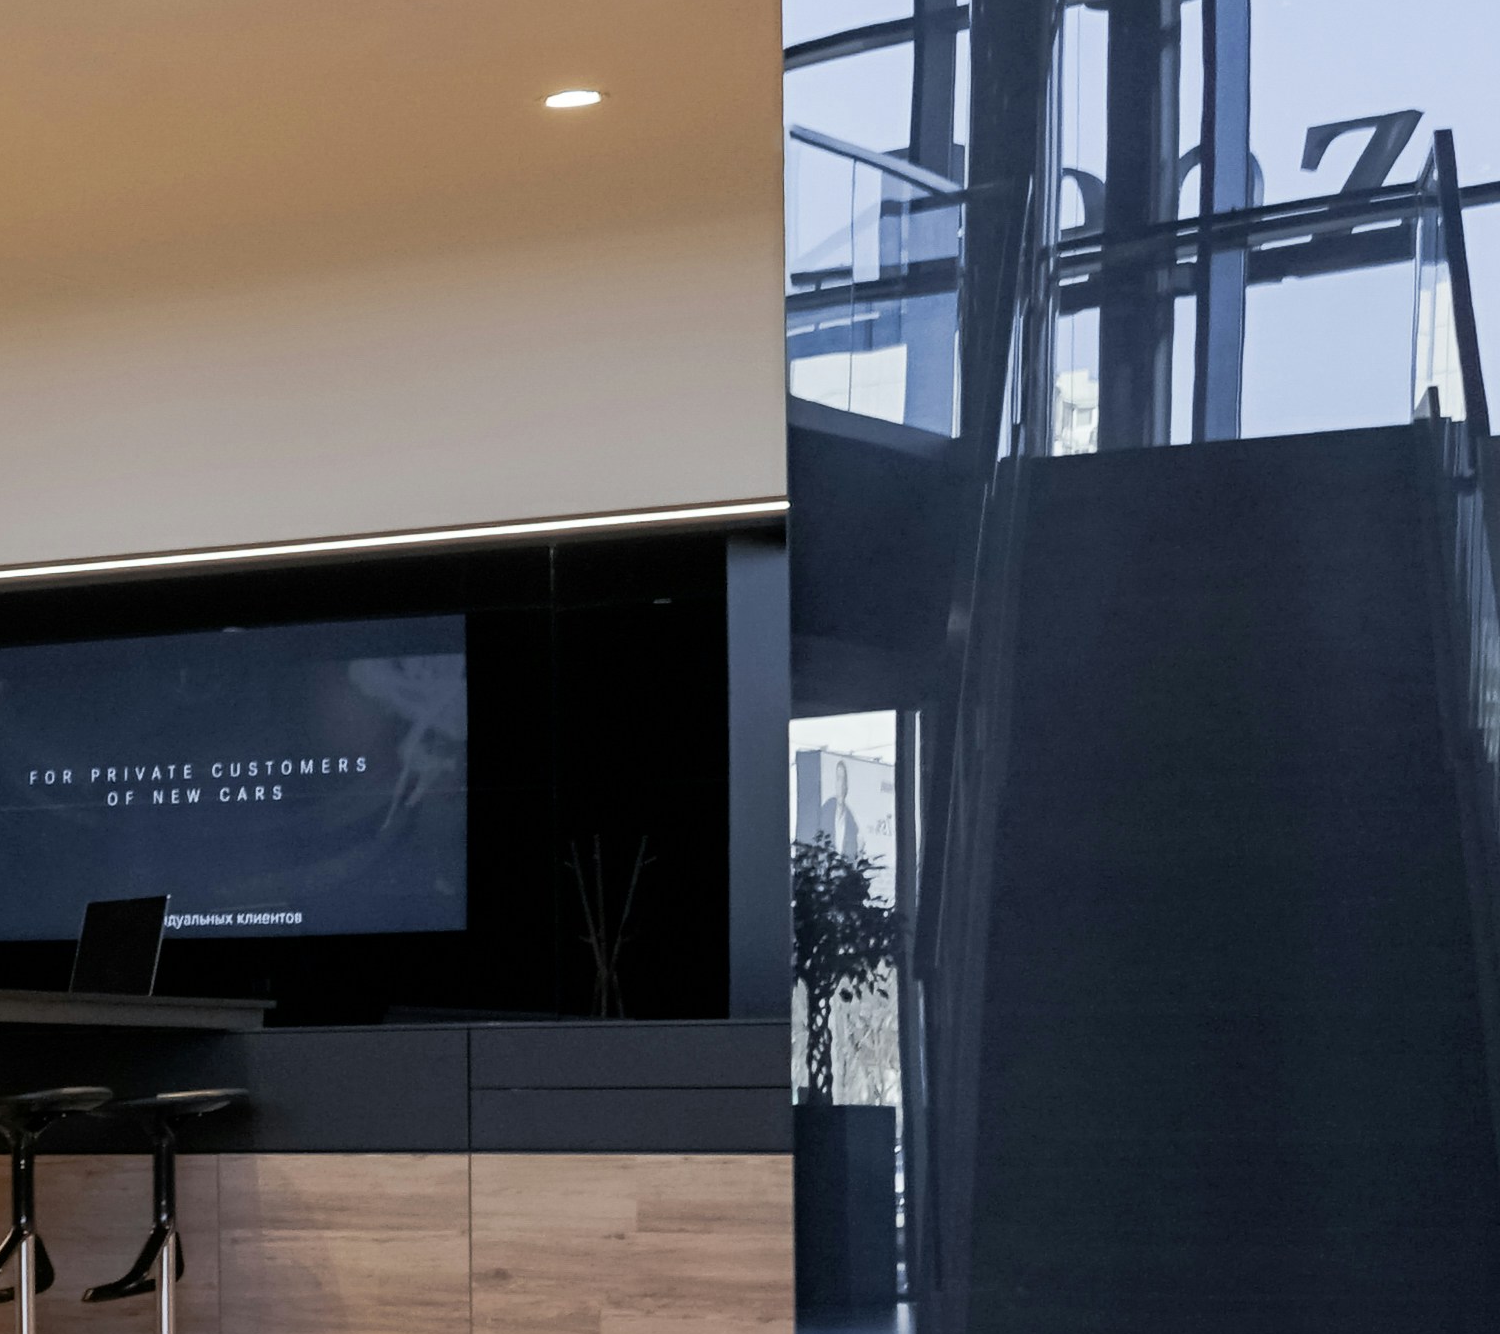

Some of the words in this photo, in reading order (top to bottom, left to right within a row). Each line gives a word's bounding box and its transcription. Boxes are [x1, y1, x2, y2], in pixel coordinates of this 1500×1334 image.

[29, 769, 73, 785] FOR
[91, 764, 193, 783] PRIVATE
[211, 757, 367, 778] CUSTOMERS
[107, 791, 135, 807] OF
[153, 788, 201, 804] NEW
[219, 785, 283, 802] CARS
[236, 912, 303, 926] клиентов
